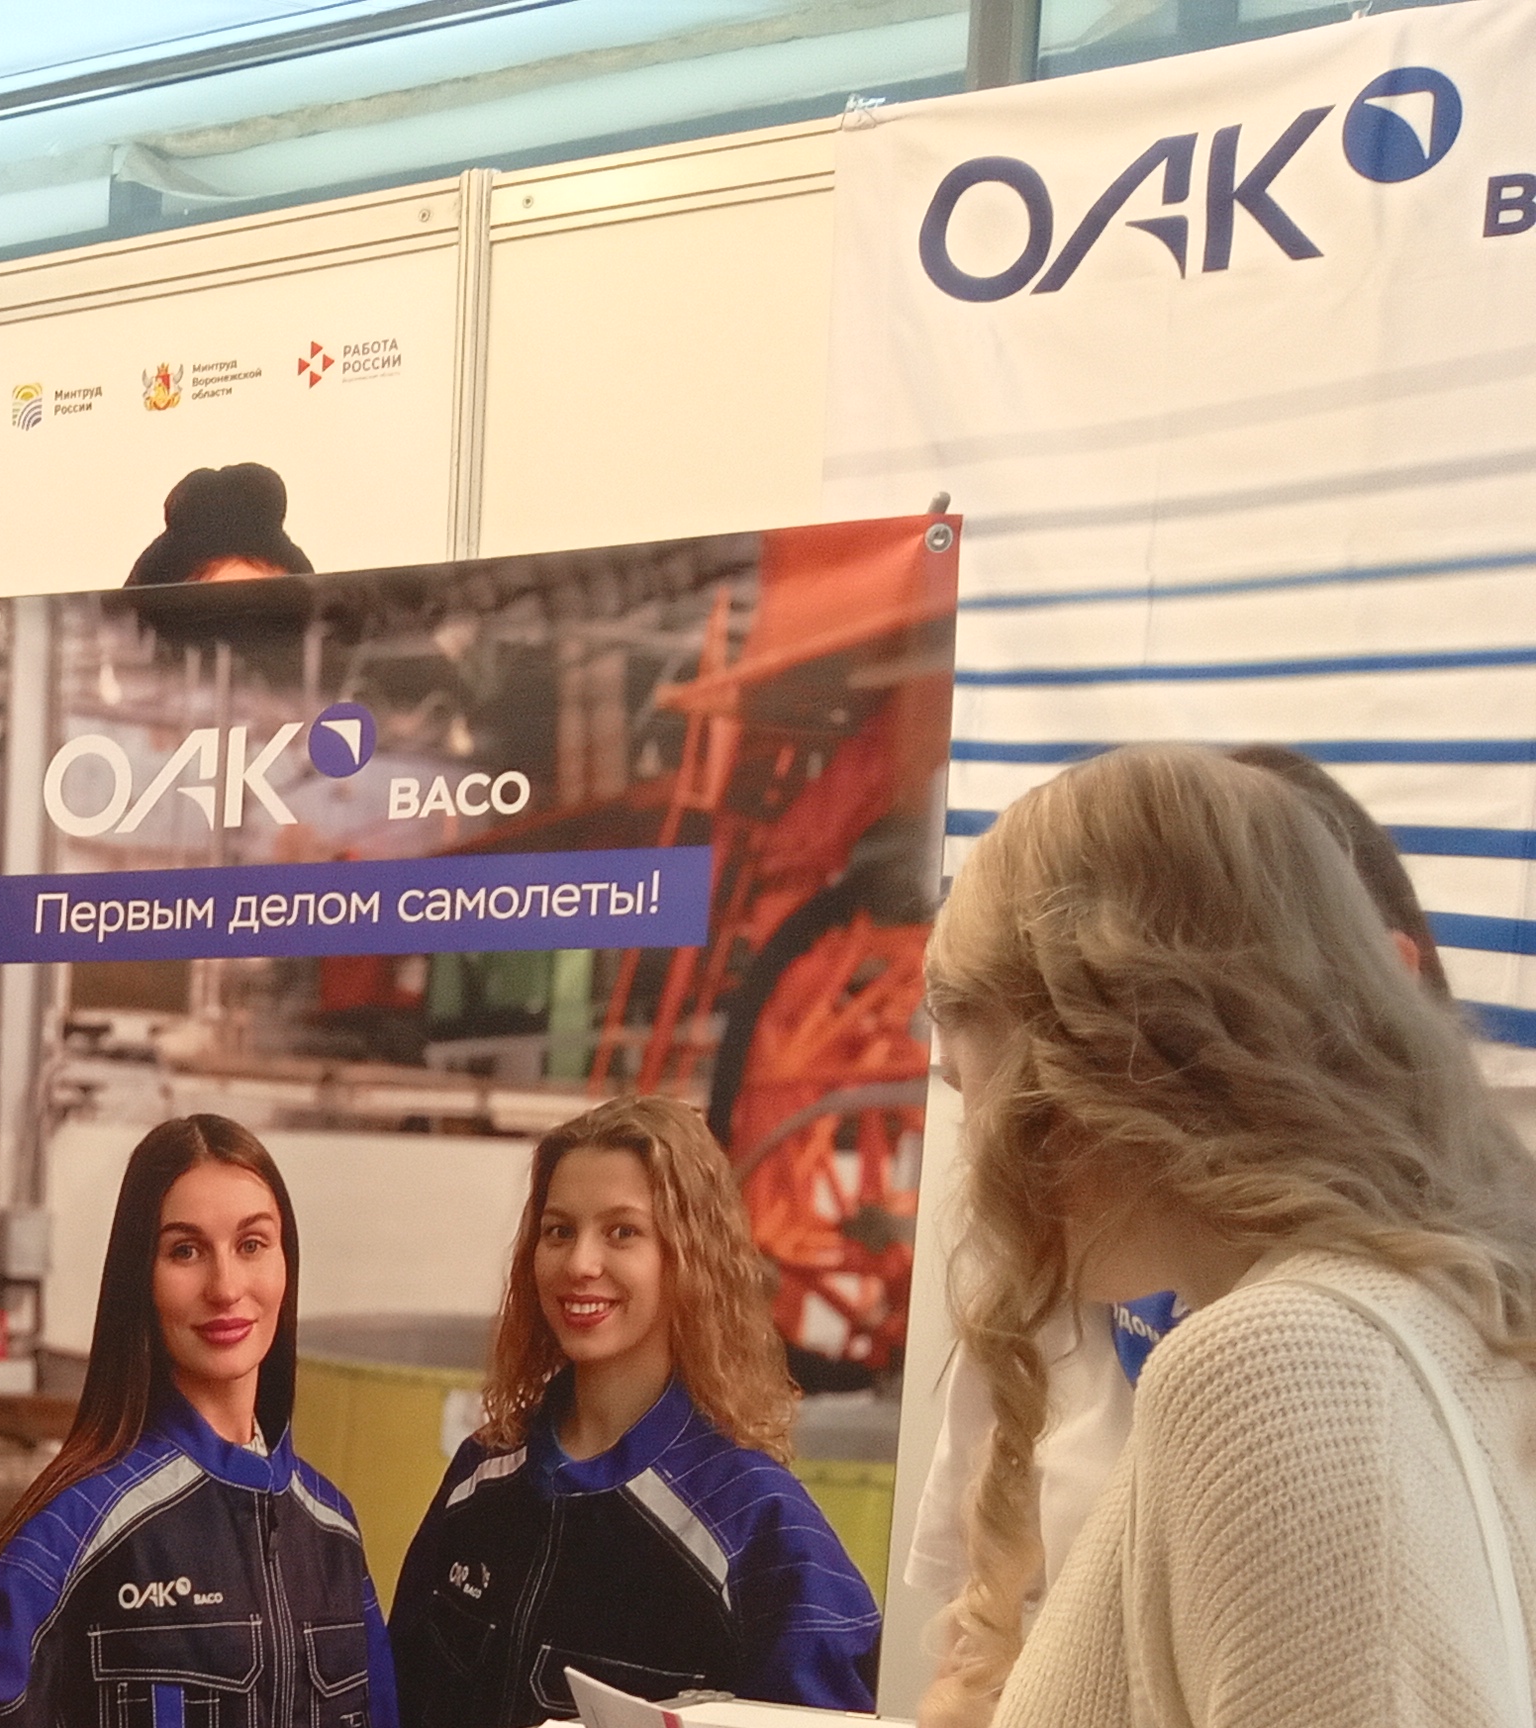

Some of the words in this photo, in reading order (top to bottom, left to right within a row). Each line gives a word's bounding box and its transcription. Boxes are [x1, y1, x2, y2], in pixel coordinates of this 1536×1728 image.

[918, 104, 1336, 303] ОАК
[342, 338, 399, 358] РАБОТА
[192, 359, 238, 374] Минтруд
[342, 354, 402, 375] РОССИИ
[192, 368, 263, 388] Воронежской
[54, 386, 103, 402] Минтруд
[191, 387, 233, 400] области
[54, 401, 93, 416] России
[42, 721, 307, 837] ОАК
[387, 770, 530, 821] ВАСО
[33, 890, 215, 944] Первым
[228, 882, 381, 935] делом
[396, 869, 663, 921] самолеты!
[118, 1580, 178, 1610] ОАК
